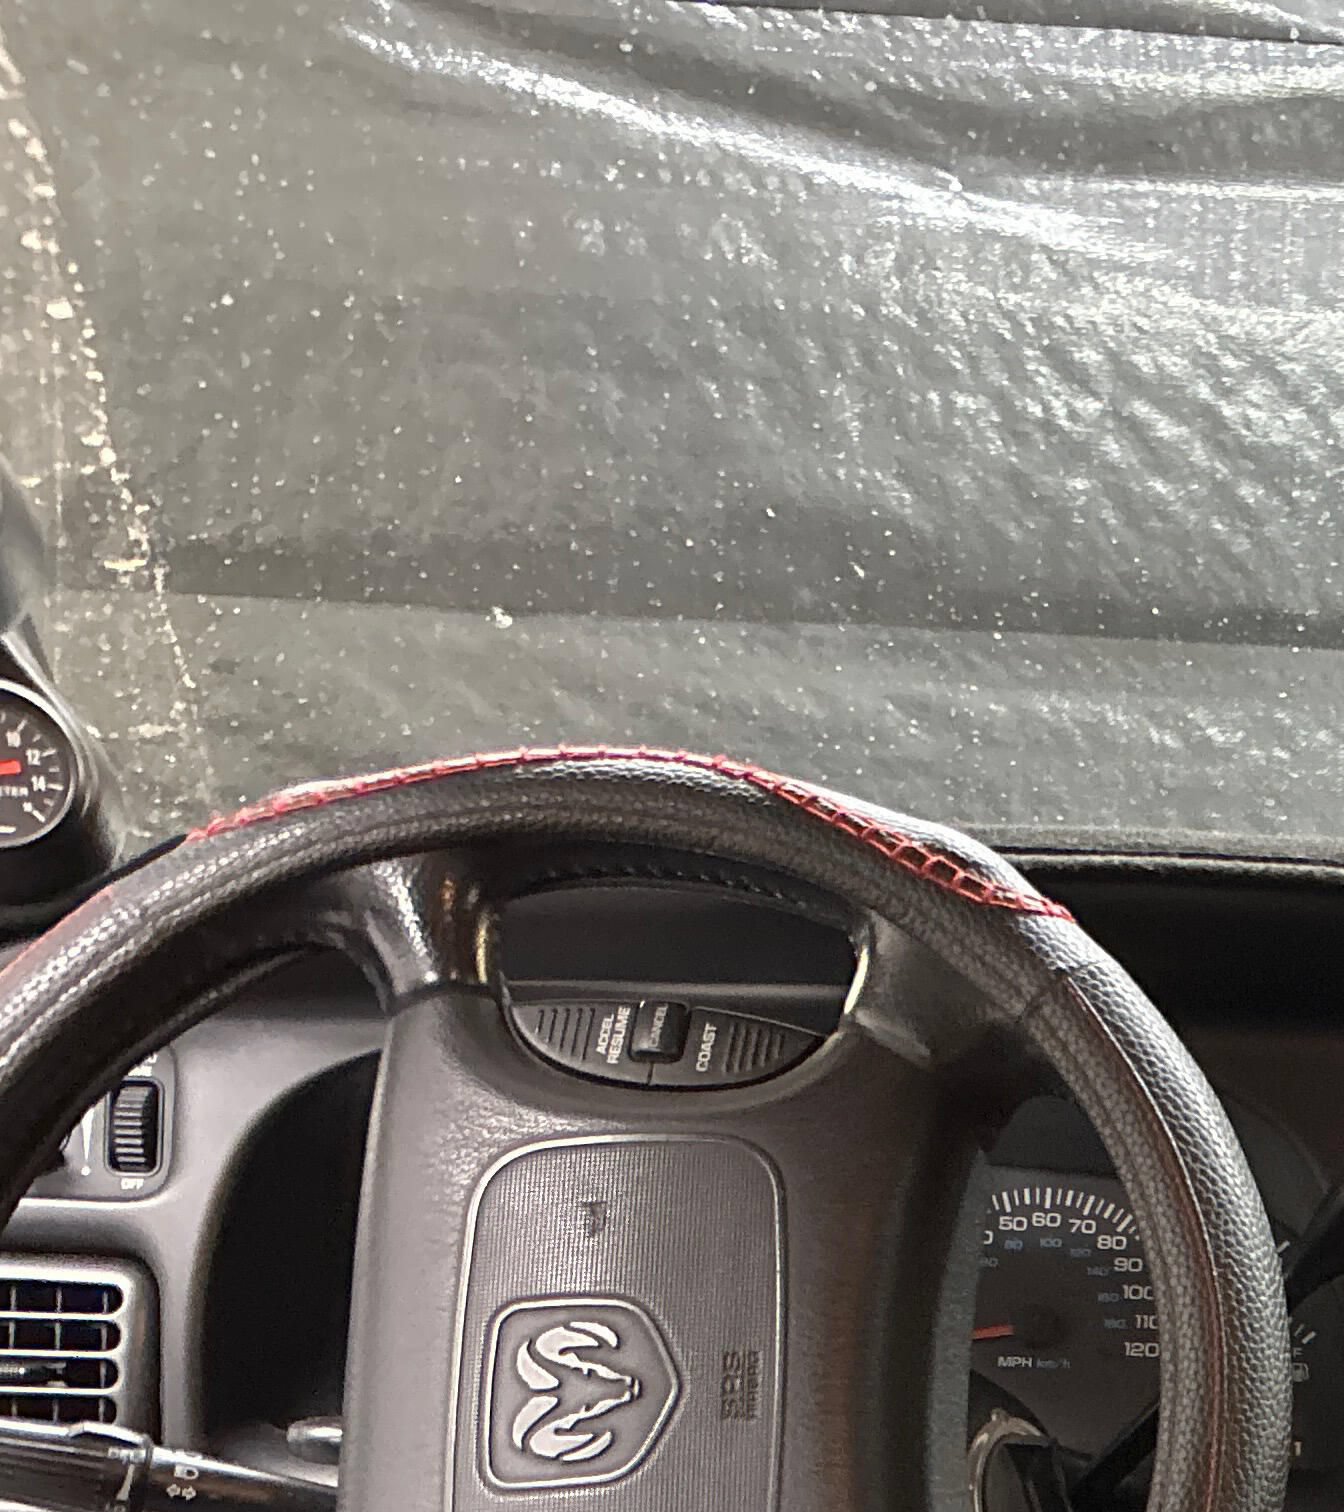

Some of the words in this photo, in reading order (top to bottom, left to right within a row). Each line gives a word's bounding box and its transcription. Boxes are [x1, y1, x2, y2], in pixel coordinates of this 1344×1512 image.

[25, 748, 40, 766] 12
[31, 775, 46, 791] 14
[596, 1014, 615, 1055] ACCEL
[606, 1006, 631, 1064] RESUME
[696, 1022, 717, 1072] COAST
[999, 1216, 1028, 1231] 50
[1032, 1212, 1061, 1227] 60
[1069, 1219, 1097, 1234] 70
[1097, 1235, 1127, 1250] 80
[1114, 1257, 1143, 1272] 90
[1122, 1284, 1153, 1300] 100
[1125, 1342, 1160, 1358] 120
[998, 1356, 1032, 1368] MPH
